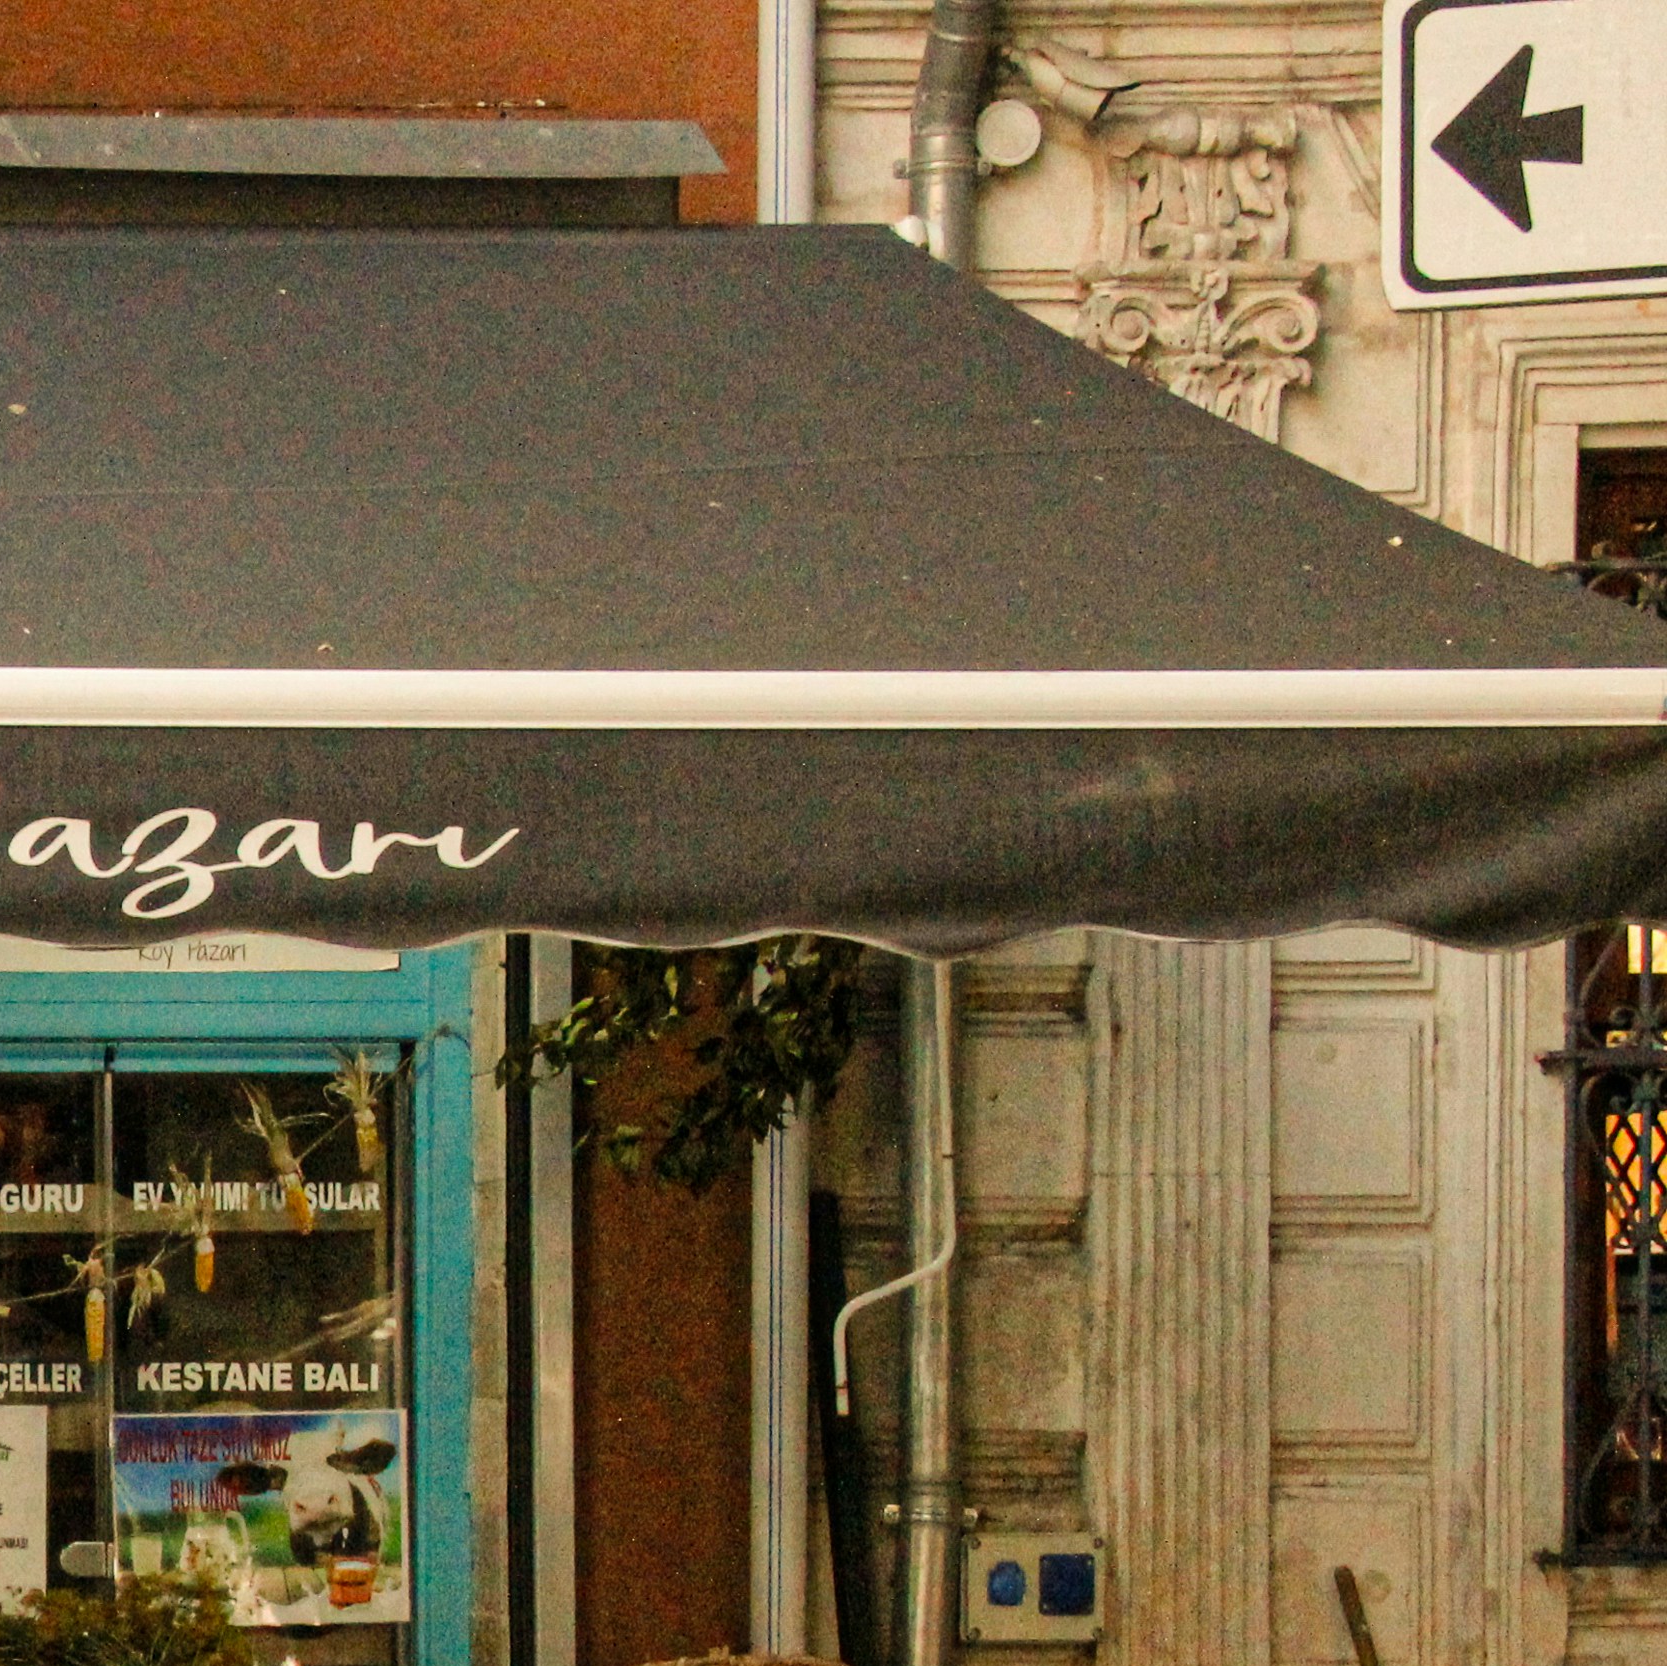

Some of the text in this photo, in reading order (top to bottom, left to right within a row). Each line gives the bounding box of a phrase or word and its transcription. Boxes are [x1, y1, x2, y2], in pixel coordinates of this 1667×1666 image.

[133, 1181, 164, 1211] EV
[136, 1362, 380, 1392] KESTANE BALI
